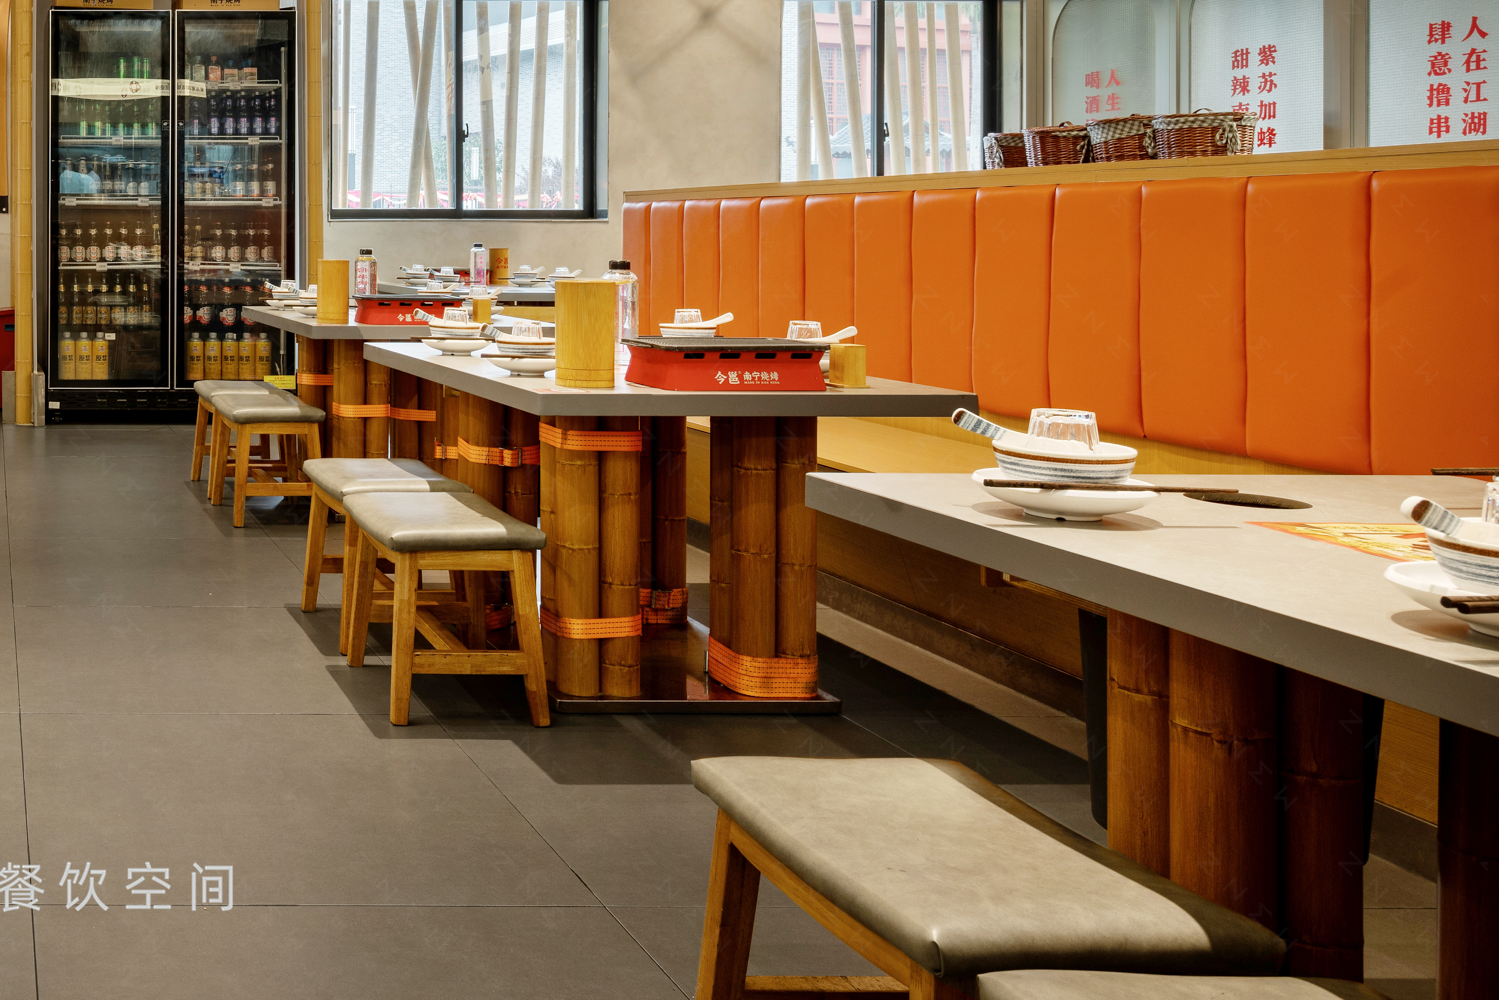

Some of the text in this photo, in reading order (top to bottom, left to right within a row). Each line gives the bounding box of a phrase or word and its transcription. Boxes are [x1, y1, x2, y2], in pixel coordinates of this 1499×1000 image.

[1085, 70, 1101, 124] 喝酒
[1257, 43, 1278, 149] 紫苏加蜂
[1426, 19, 1453, 139] 肆意撸串
[1460, 15, 1489, 137] 人在江湖
[714, 370, 779, 385] 今邕 南宁烧烤
